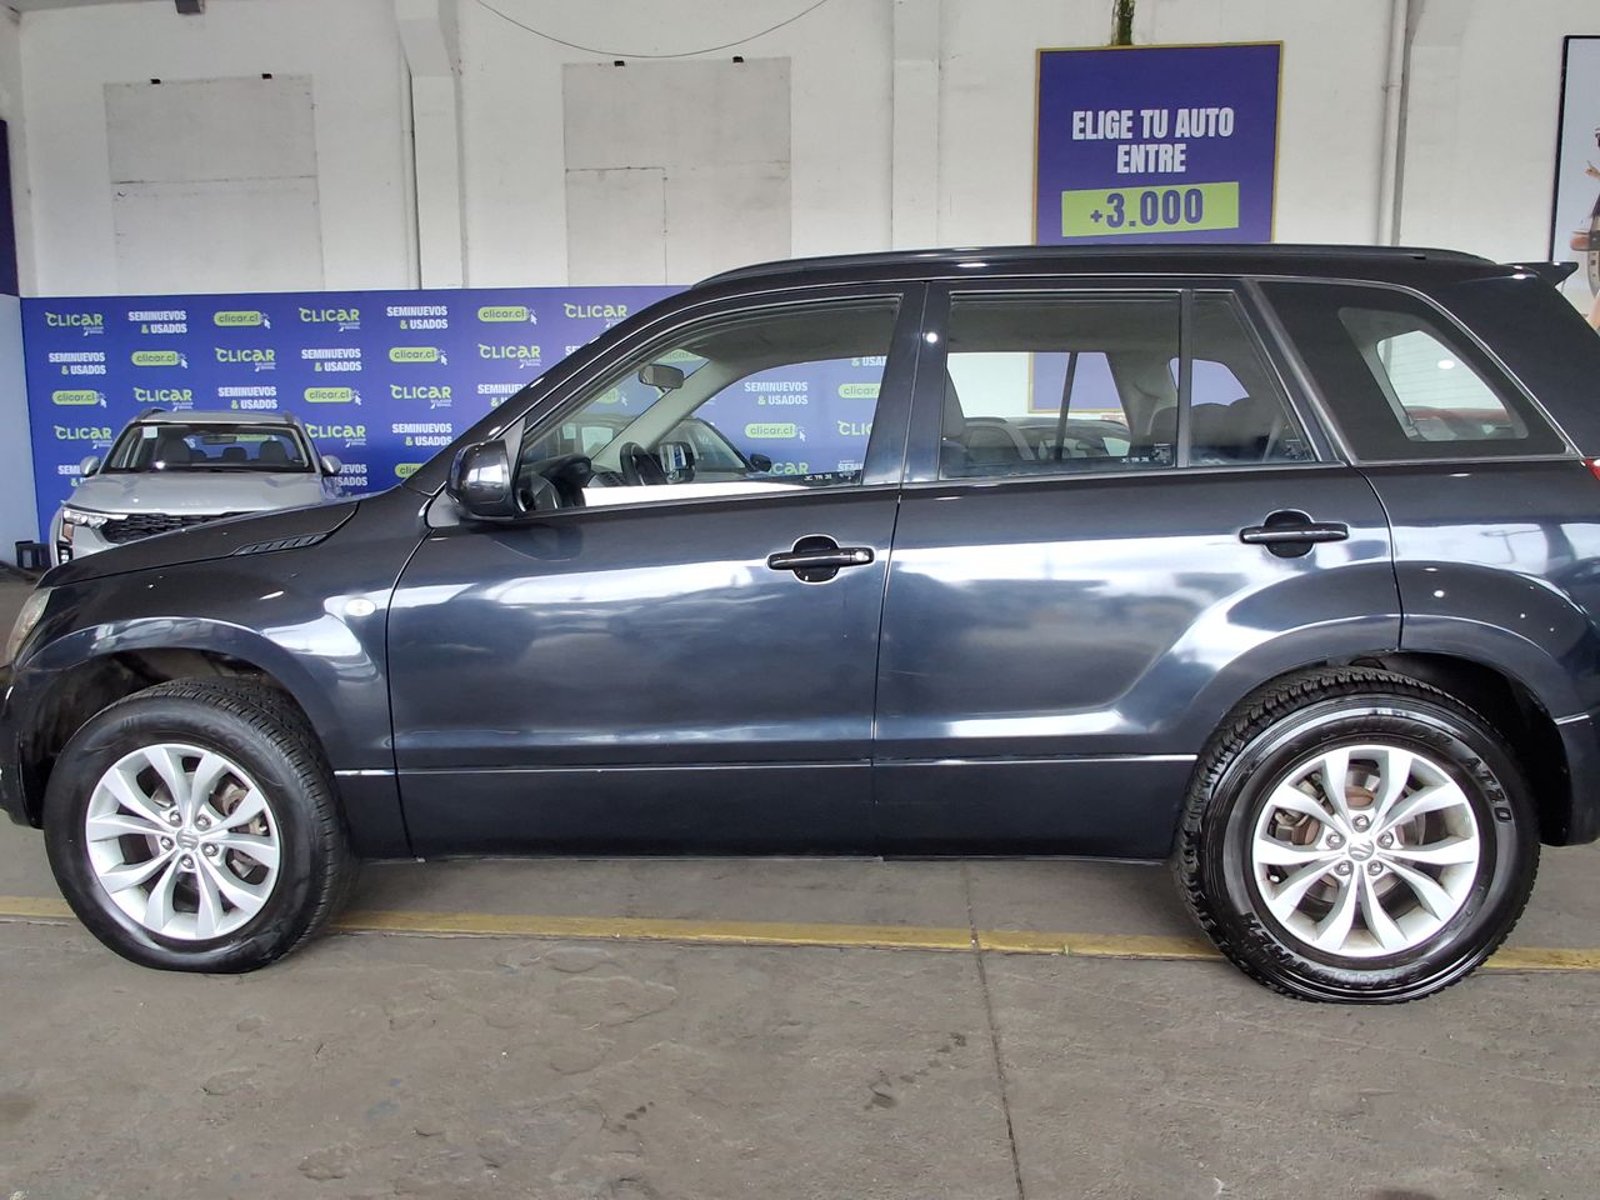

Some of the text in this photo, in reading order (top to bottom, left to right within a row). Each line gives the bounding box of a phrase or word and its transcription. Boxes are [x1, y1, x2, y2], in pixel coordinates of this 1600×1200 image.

[1072, 107, 1234, 140] ELIGE TU AUTO
[1116, 143, 1186, 174] ENTRE
[1090, 188, 1203, 228] +3.000
[128, 310, 187, 321] SEMINUEVOS
[386, 306, 448, 317] SEMINUEVOS
[483, 310, 525, 319] clicar.cl
[219, 314, 259, 323] clicar.cl
[141, 324, 187, 334] & USADOS
[400, 319, 448, 330] & USADOS
[48, 352, 106, 363] SEMINUEVOS
[136, 353, 176, 362] clicar.cl
[301, 348, 361, 359] SEMINUEVOS
[394, 350, 435, 359] clicar.cl
[61, 365, 106, 376] & USADOS
[315, 361, 362, 372] & USADOS
[218, 386, 277, 397] SEMINUEVOS
[744, 382, 808, 393] SEMINUEVOS
[844, 386, 877, 395] clicar.
[309, 390, 350, 399] clicar.cl
[758, 395, 808, 405] & USADOS
[231, 399, 278, 410] & USADOS
[392, 423, 452, 434] SEMINUEVOS
[750, 426, 793, 435] clicar.cl
[405, 436, 452, 446] & USADOS
